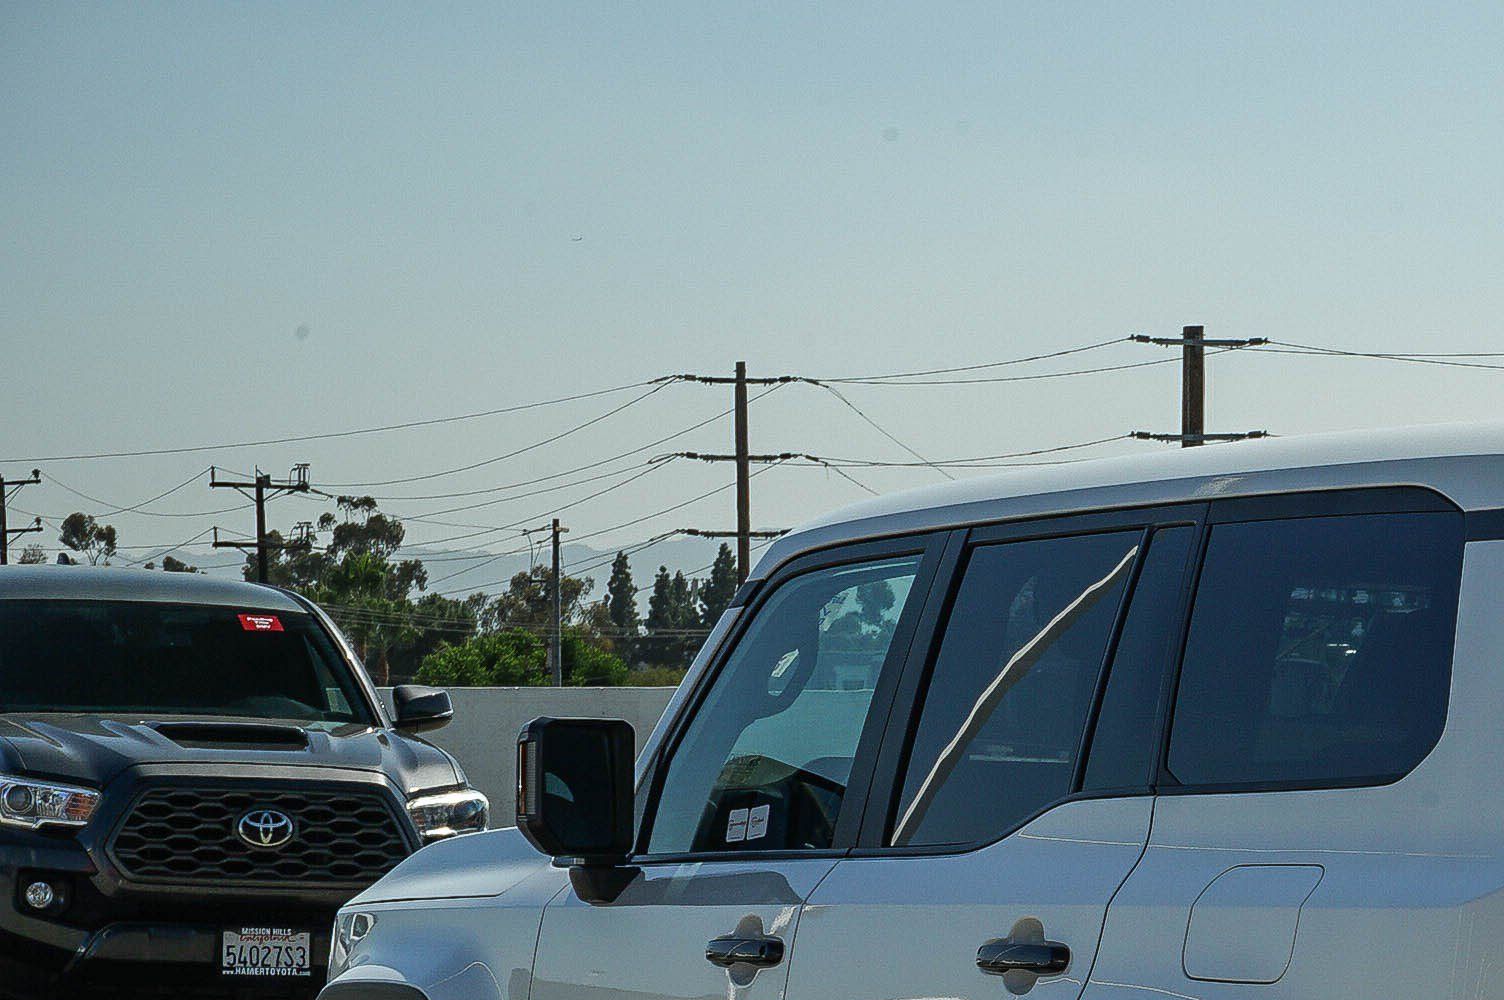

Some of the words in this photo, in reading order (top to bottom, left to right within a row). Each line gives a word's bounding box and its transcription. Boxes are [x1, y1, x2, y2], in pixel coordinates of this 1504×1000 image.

[242, 928, 270, 936] MISSION
[272, 928, 292, 936] HILLS
[226, 945, 306, 968] 54027S3
